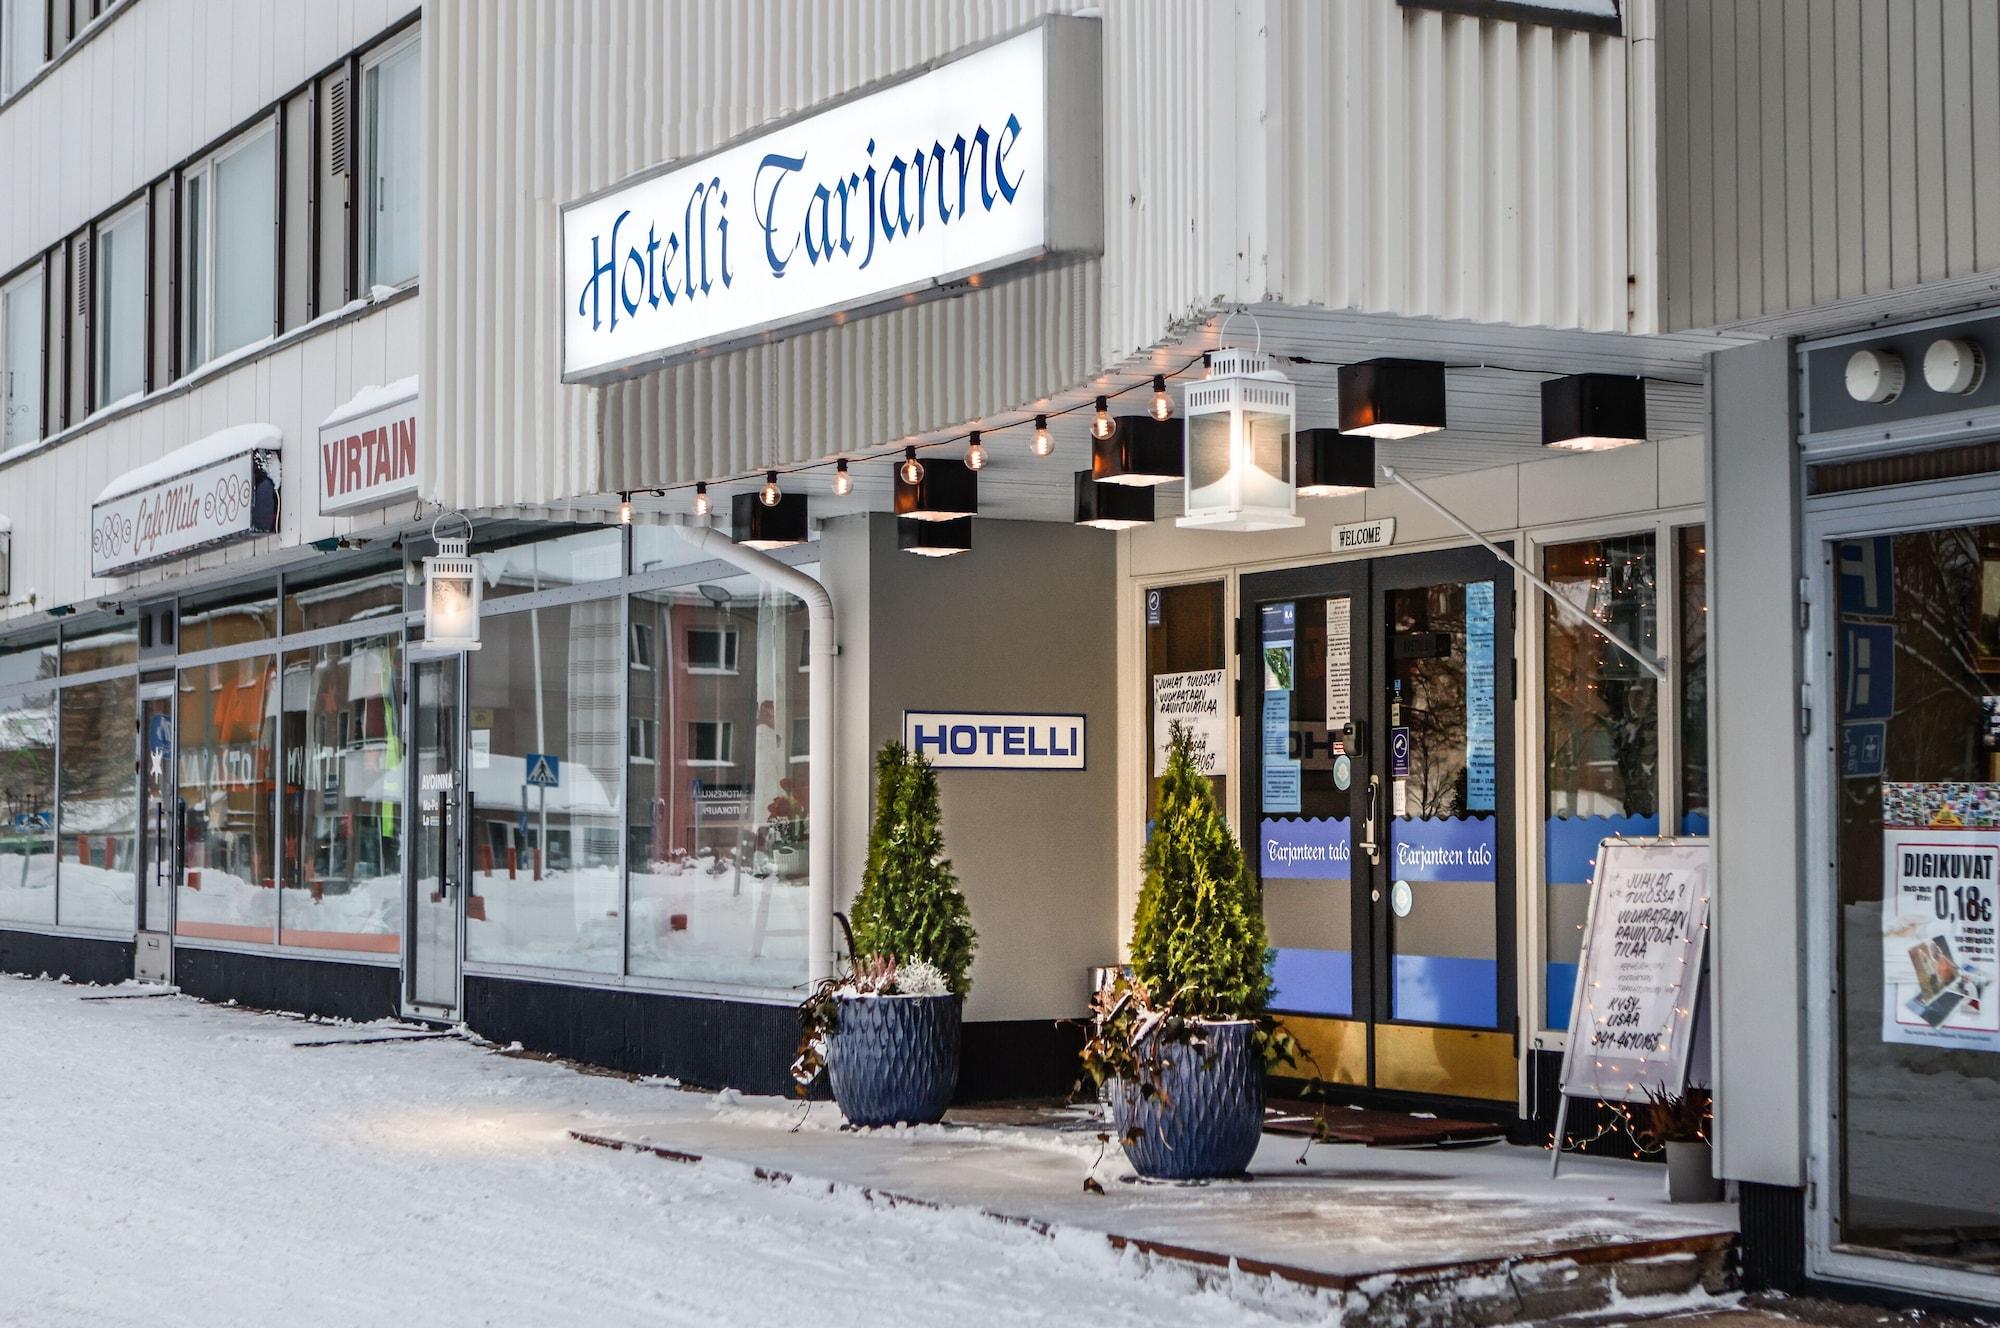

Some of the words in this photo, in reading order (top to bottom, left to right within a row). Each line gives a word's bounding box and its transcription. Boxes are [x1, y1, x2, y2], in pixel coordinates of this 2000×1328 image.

[579, 176, 734, 334] Hotelli
[753, 112, 1026, 279] Tarjanne
[323, 416, 417, 498] VIRTAIN
[1338, 525, 1382, 547] WELCOME
[1158, 675, 1183, 690] JUHLAT
[914, 724, 1077, 756] HOTELLI
[421, 773, 454, 790] AVOINNA
[1267, 839, 1325, 866] Tarjanteen
[1328, 840, 1350, 861] talo
[1396, 842, 1463, 871] Tarjanteen
[1467, 843, 1492, 865] talo
[1904, 853, 1993, 880] DIGIKUVAT
[1627, 872, 1673, 890] JUHLAT
[1617, 906, 1688, 930] VUOKRATAAN
[1613, 942, 1648, 959] TILAA
